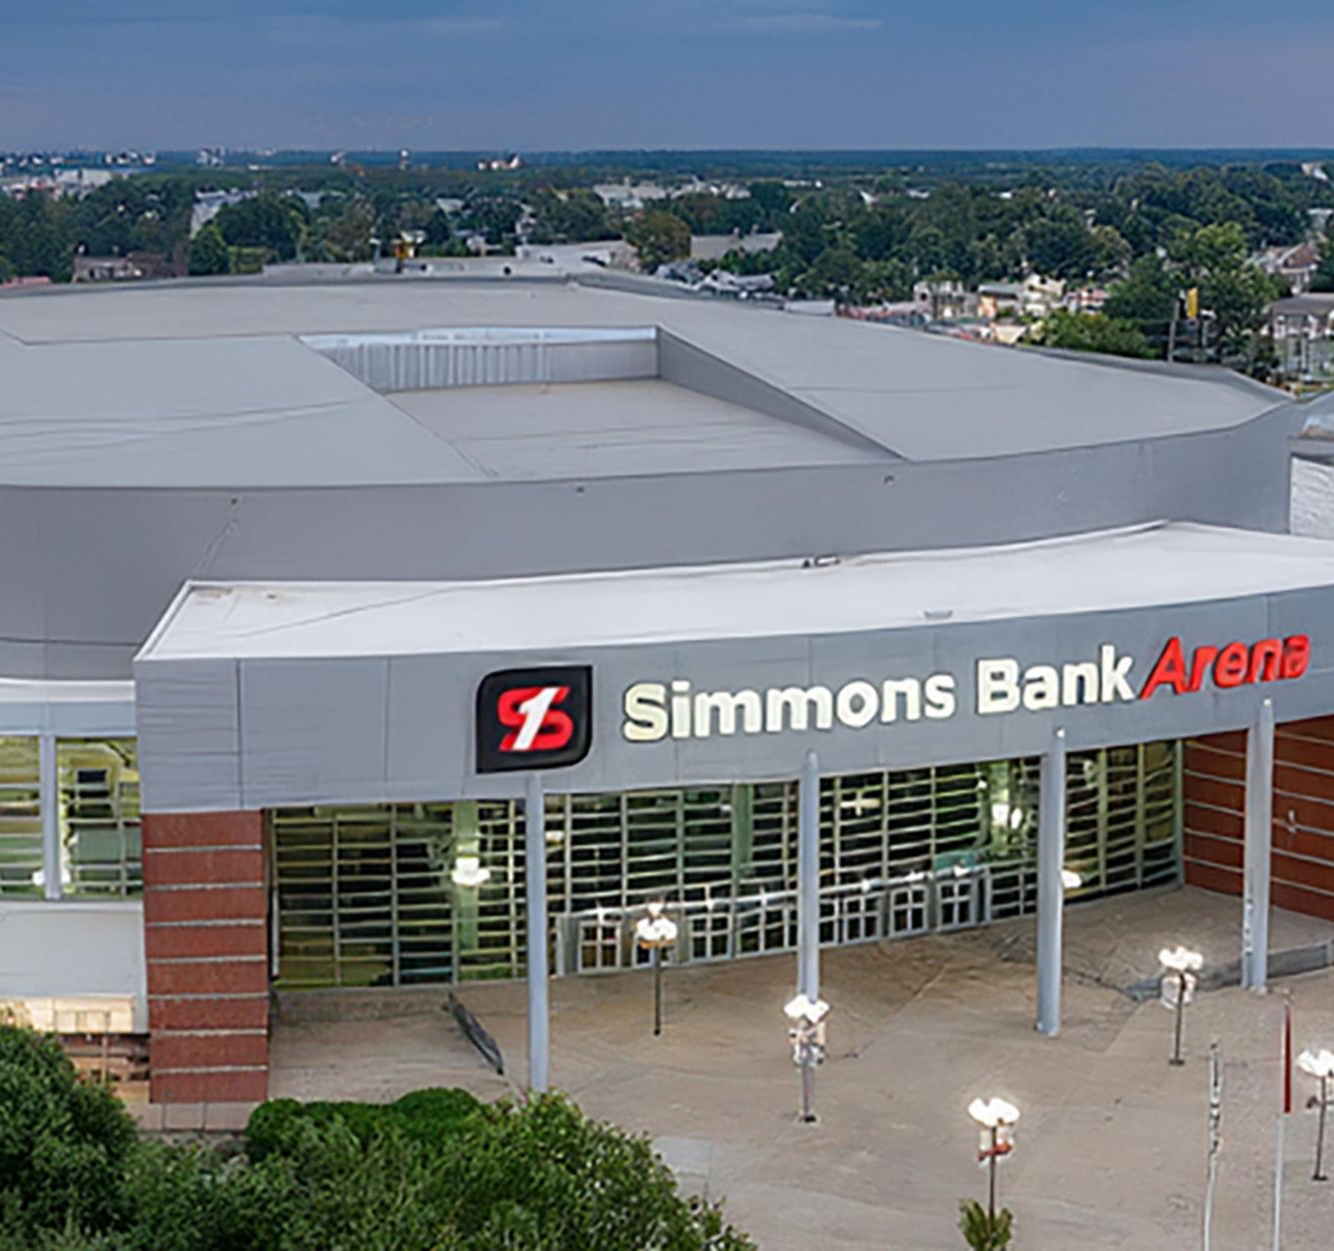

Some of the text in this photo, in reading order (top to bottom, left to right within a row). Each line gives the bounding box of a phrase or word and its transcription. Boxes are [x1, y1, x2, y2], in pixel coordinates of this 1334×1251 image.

[622, 635, 1311, 742] Simmons Bank Arena
